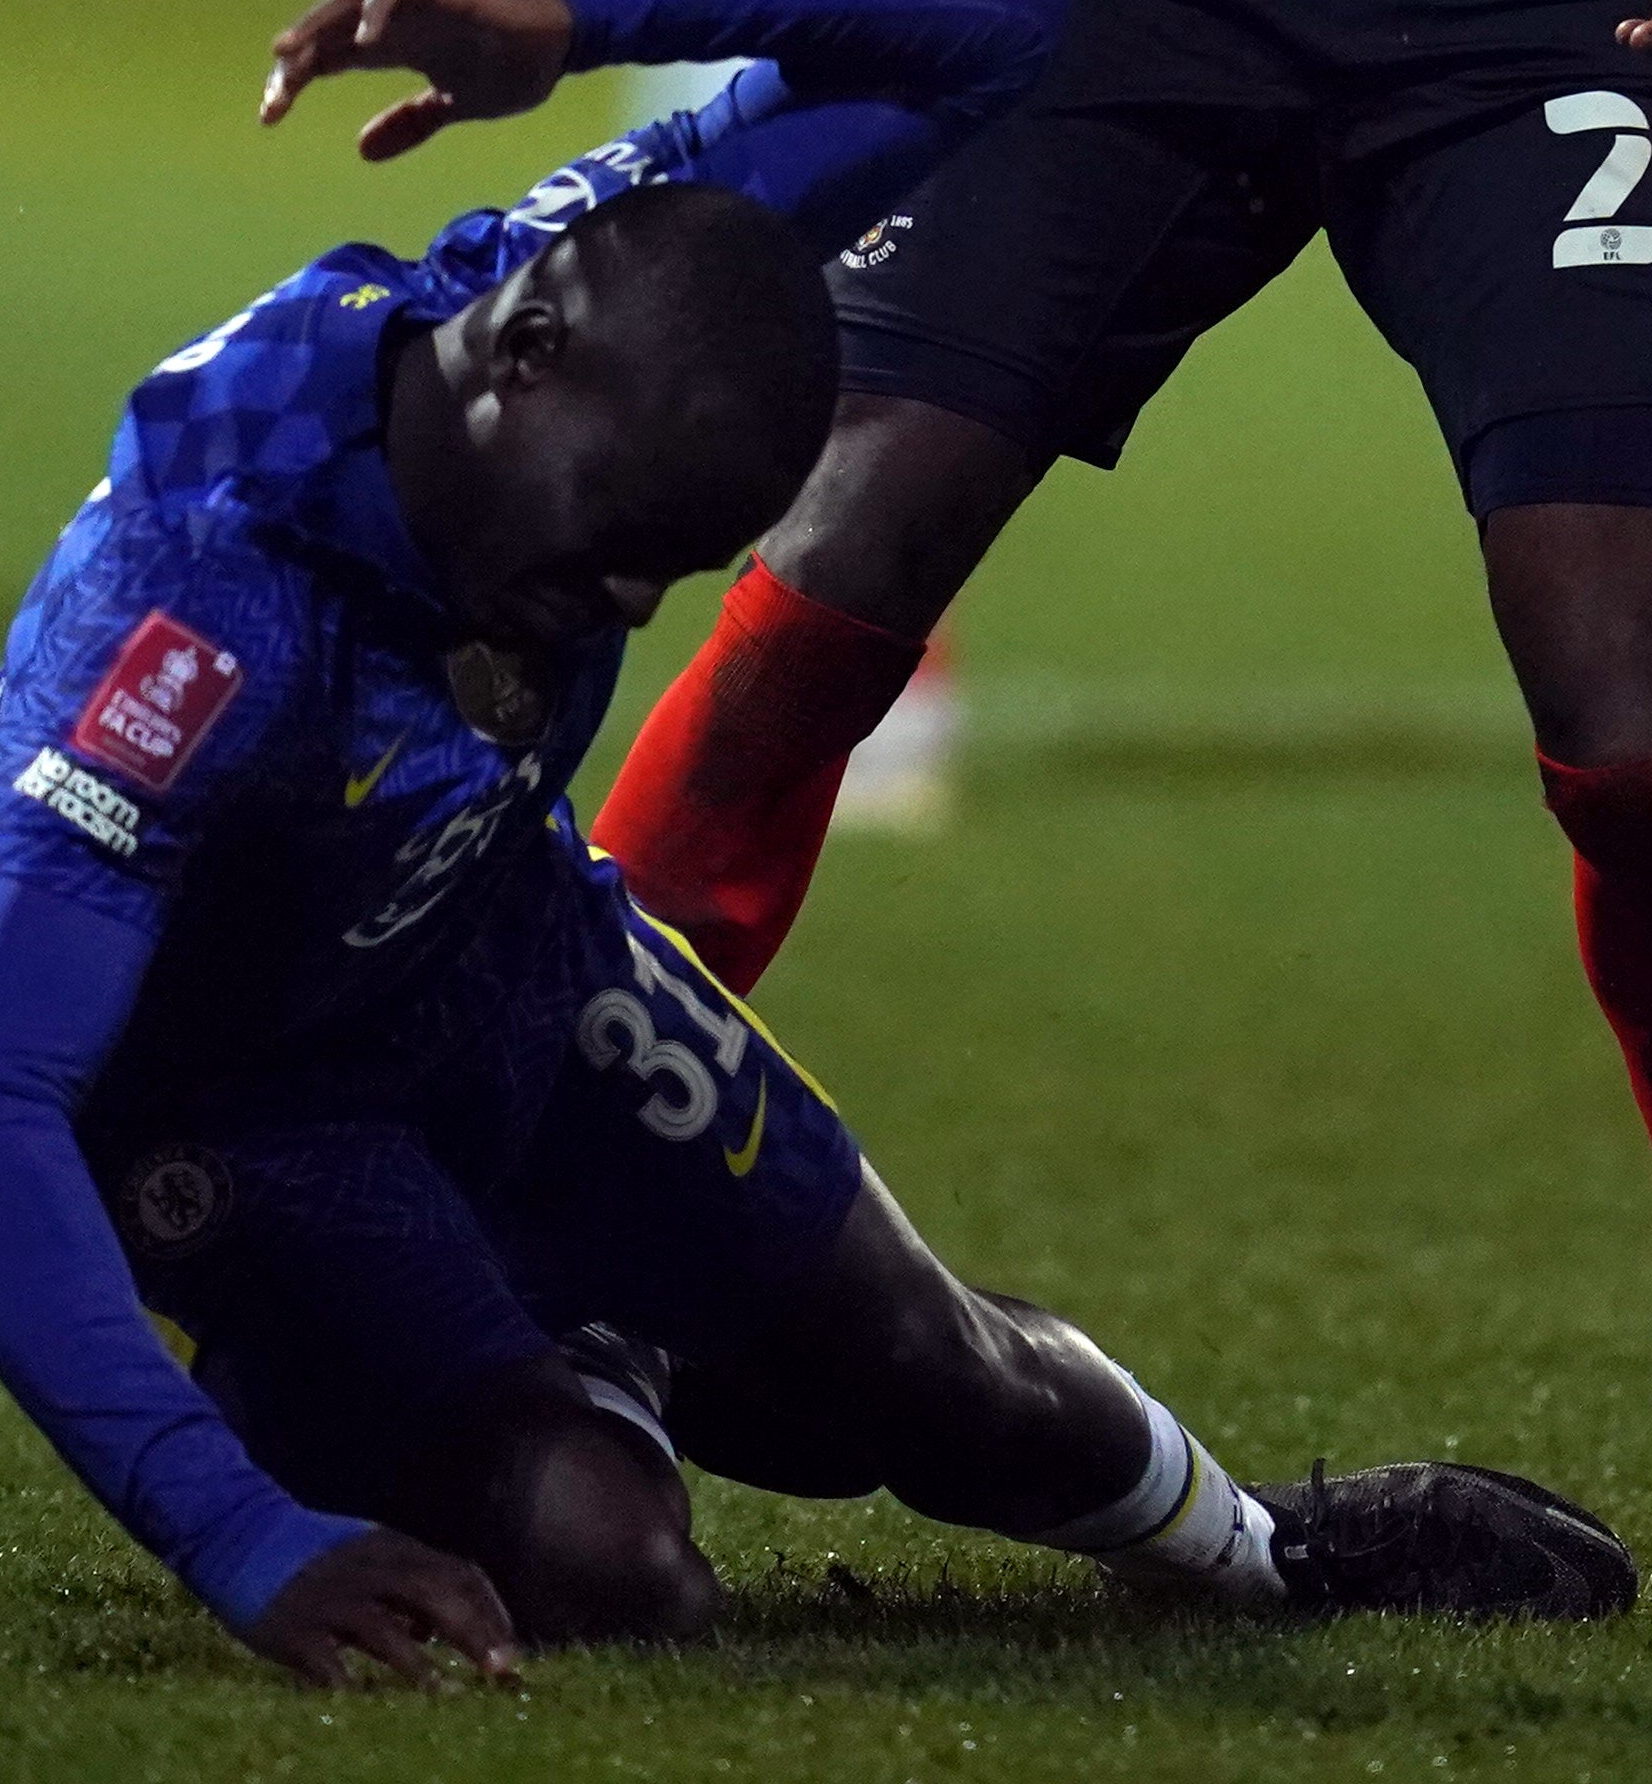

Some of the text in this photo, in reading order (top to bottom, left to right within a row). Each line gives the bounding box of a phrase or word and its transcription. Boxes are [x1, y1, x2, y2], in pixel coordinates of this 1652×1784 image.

[868, 240, 897, 266] CLUB
[1602, 251, 1622, 261] EFL
[47, 786, 139, 858] racism
[65, 767, 141, 831] room
[577, 929, 748, 1143] 31
